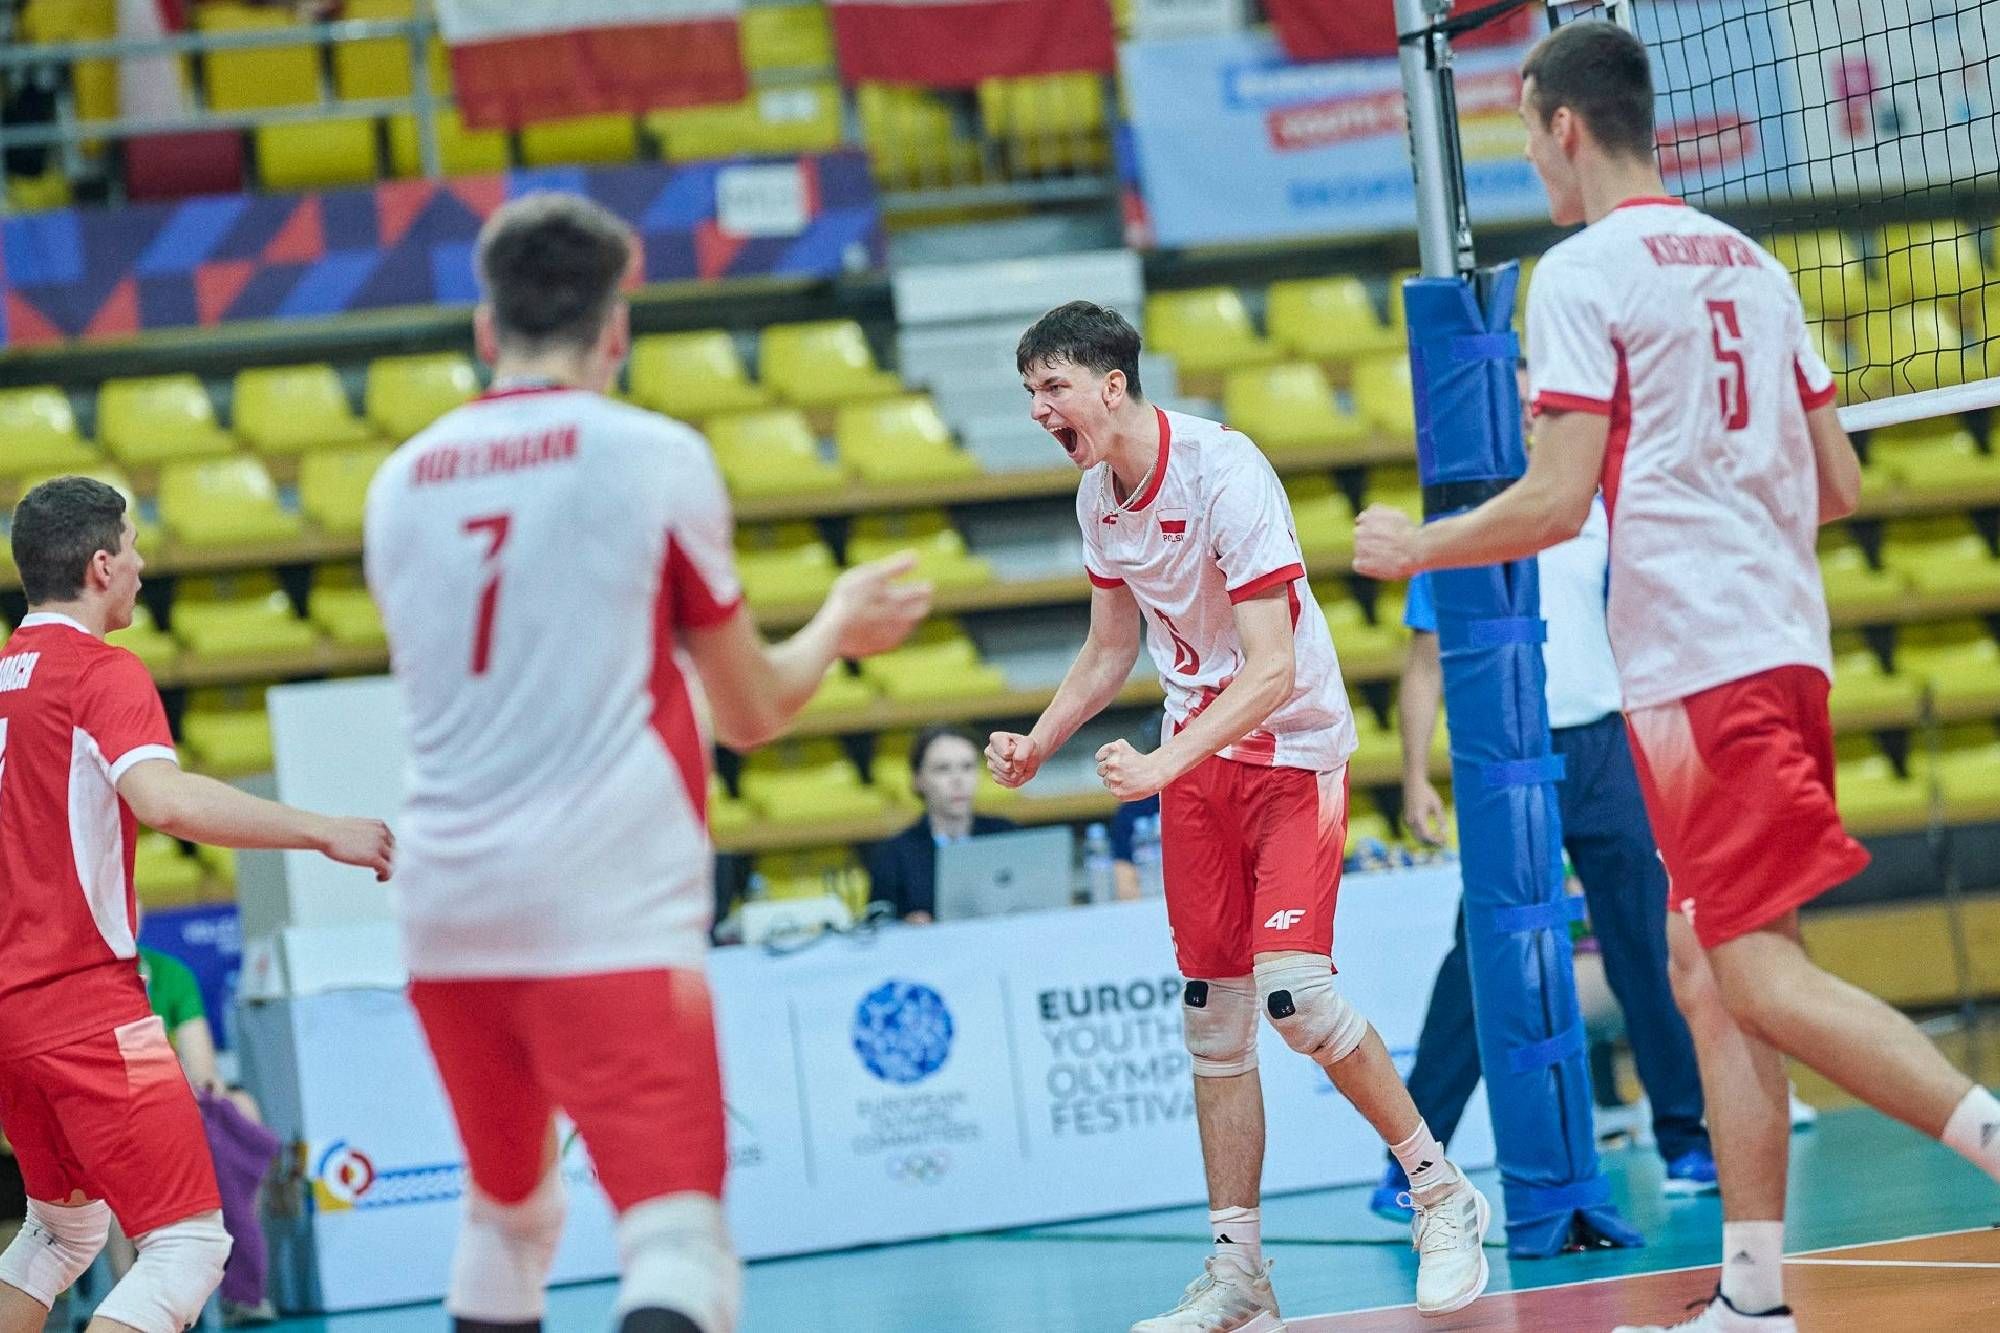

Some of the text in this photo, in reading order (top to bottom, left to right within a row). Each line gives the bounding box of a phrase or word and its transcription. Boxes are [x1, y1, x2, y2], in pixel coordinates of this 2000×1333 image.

[1706, 299, 1749, 431] 5
[461, 513, 512, 677] 7
[1264, 909, 1306, 931] 4F
[1038, 977, 1182, 1021] EUROP
[1041, 1013, 1184, 1060] YOUTH
[1047, 1052, 1191, 1100] OLYMP
[1051, 1088, 1198, 1136] FESTIVA
